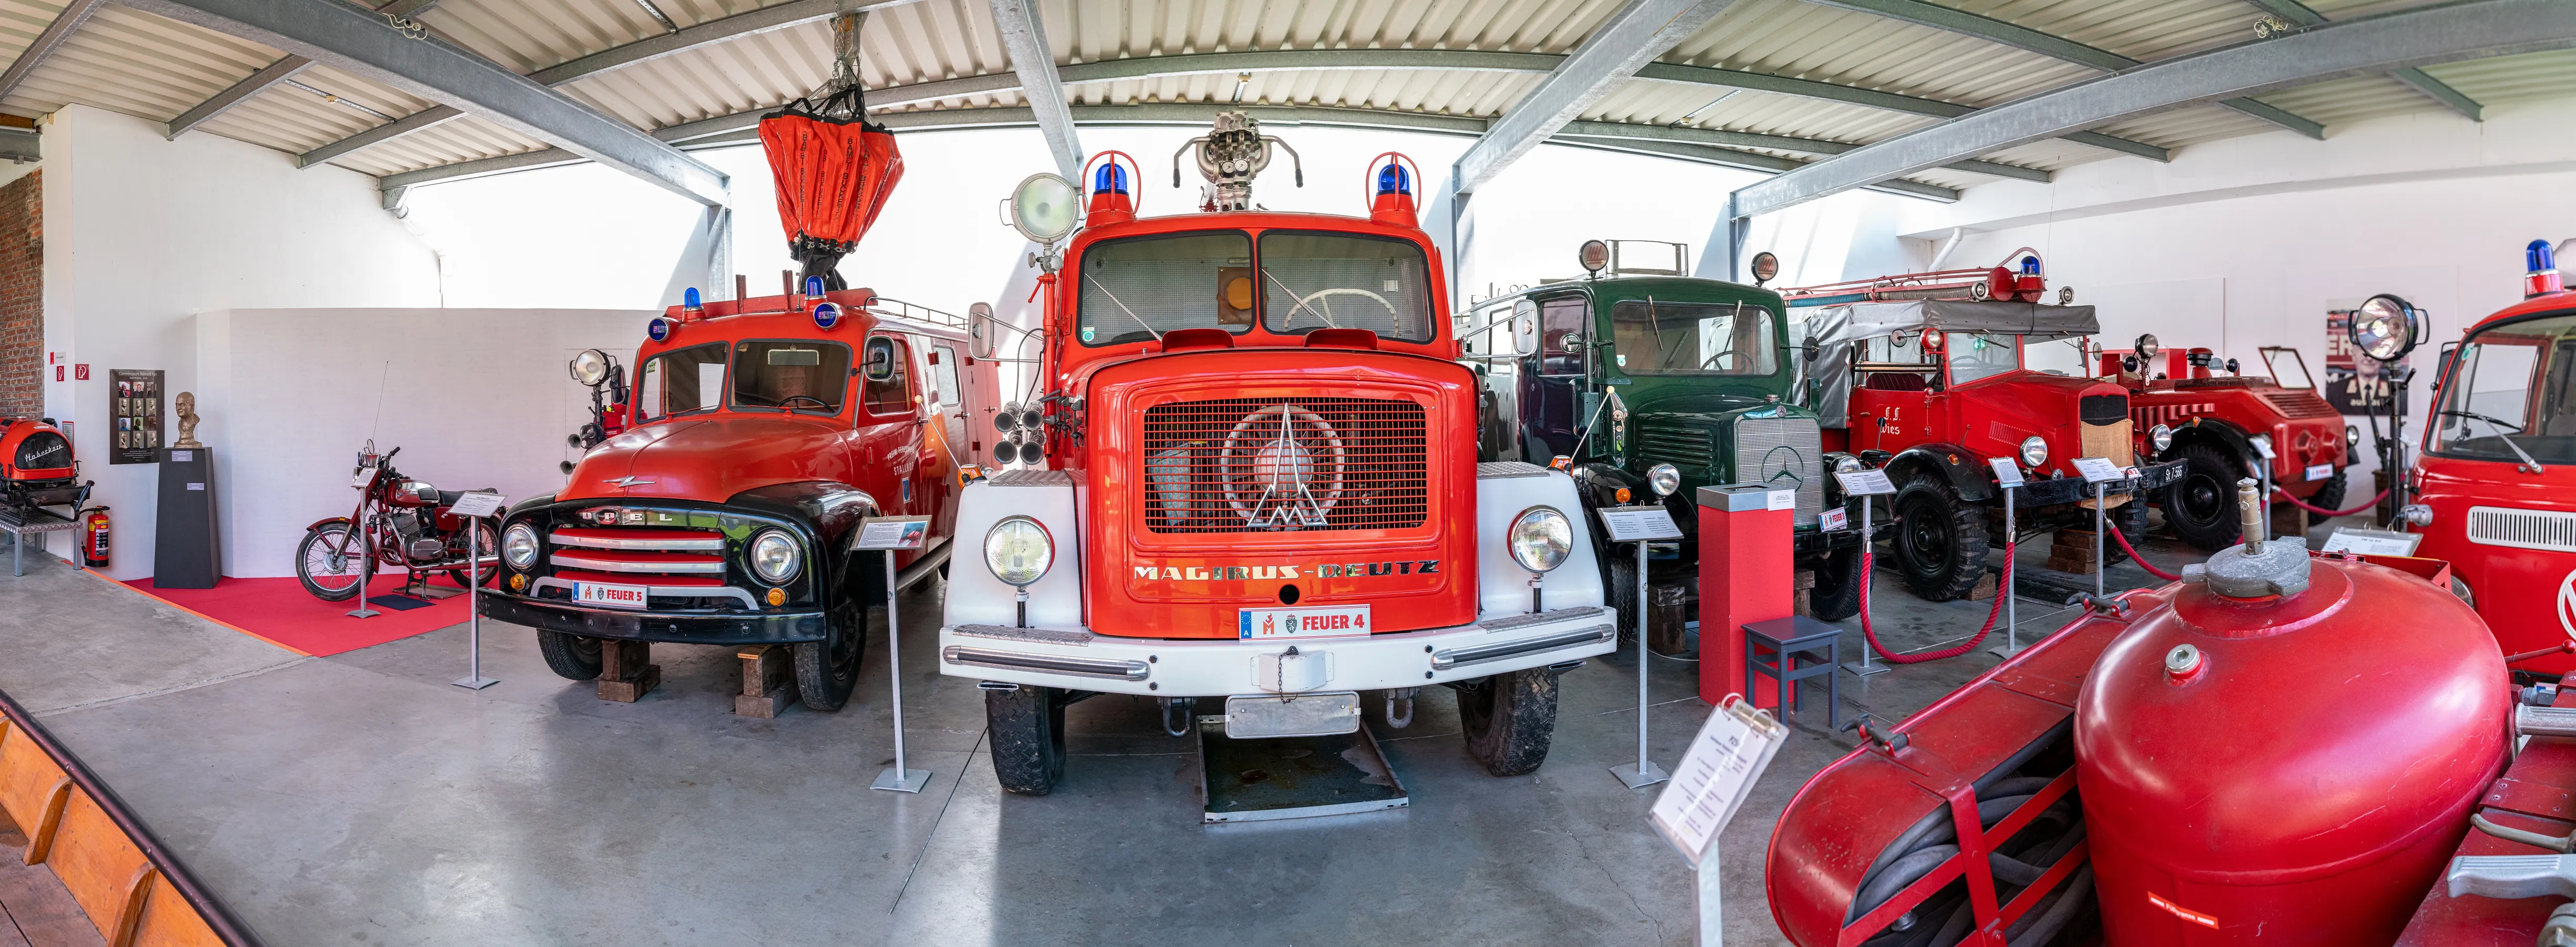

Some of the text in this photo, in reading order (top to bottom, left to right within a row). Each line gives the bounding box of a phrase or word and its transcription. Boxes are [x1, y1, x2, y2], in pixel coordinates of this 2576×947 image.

[25, 444, 64, 462] Haberkorn
[894, 461, 914, 476] STALLHOF
[582, 512, 672, 522] OPEL
[1832, 513, 1842, 522] FEUER
[1134, 560, 1439, 580] MAGIRUS-DEUTZ
[607, 589, 634, 601] FEUER
[637, 592, 642, 602] 5
[1303, 615, 1350, 631] FEUER
[1354, 614, 1365, 628] 4
